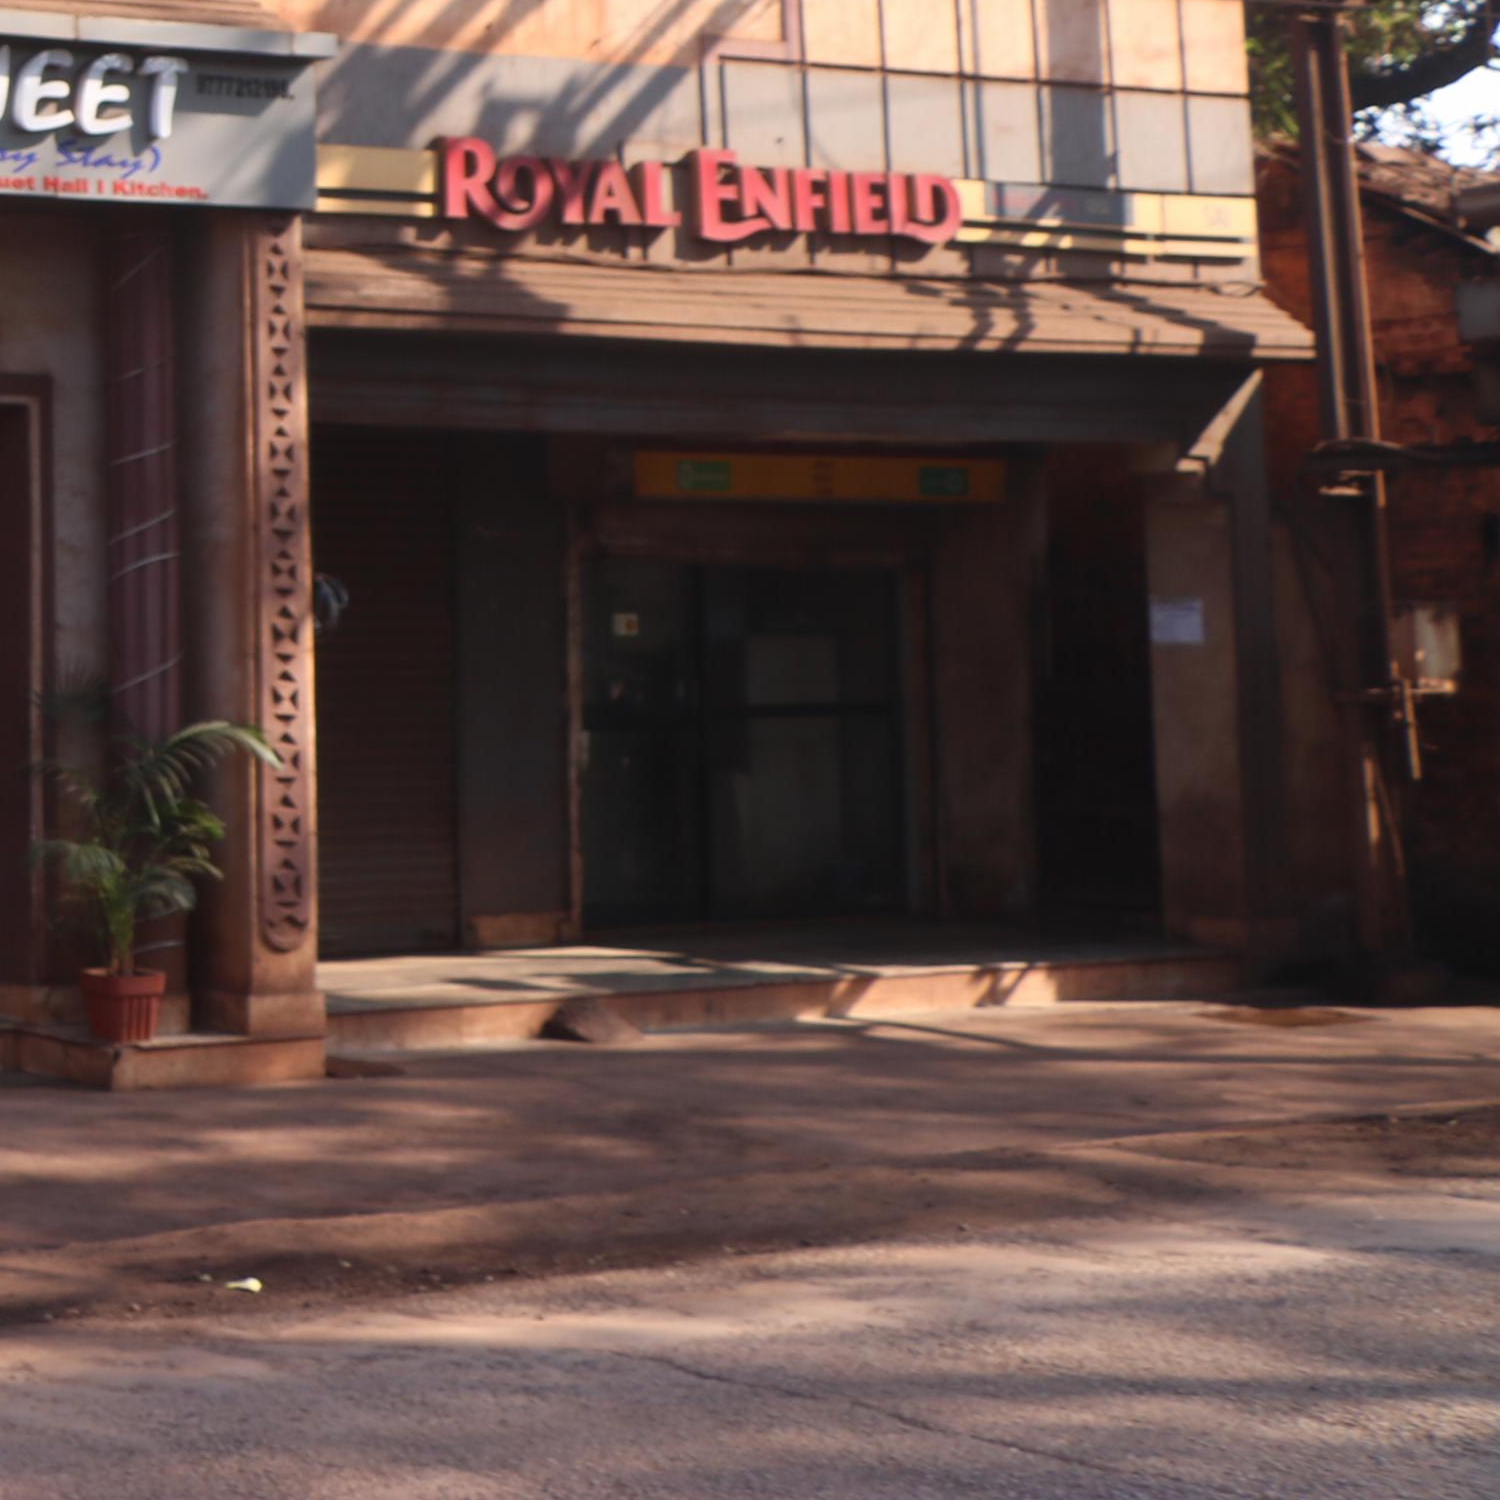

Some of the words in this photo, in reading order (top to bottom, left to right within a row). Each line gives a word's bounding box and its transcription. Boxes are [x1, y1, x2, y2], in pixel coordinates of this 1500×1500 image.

[55, 138, 162, 179] Stay)
[43, 172, 90, 195] Hall
[439, 135, 682, 231] ROYAL
[693, 147, 963, 244] ENFIELD
